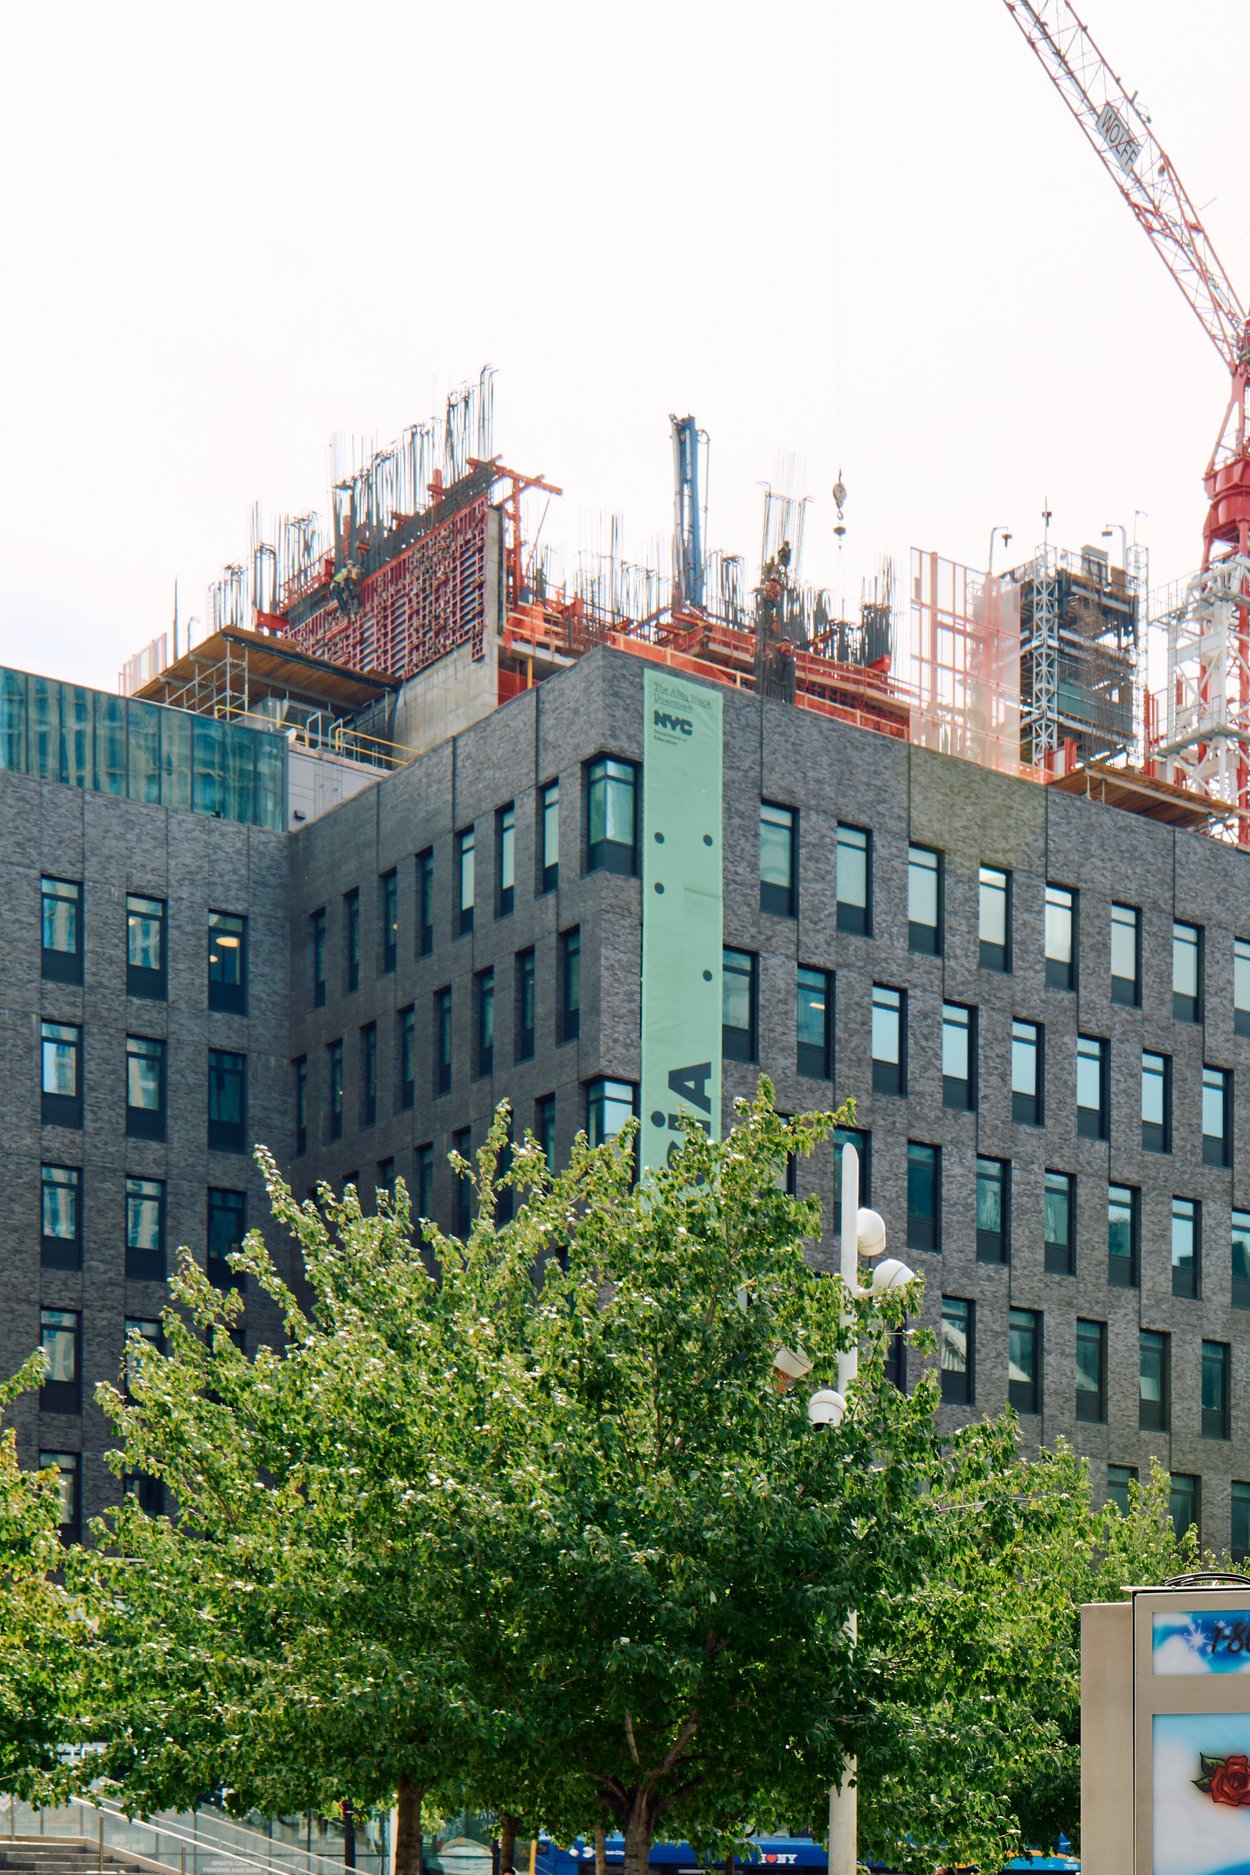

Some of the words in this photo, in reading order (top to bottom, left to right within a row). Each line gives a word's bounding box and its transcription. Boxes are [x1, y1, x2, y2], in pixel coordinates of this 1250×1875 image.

[654, 710, 693, 736] NYC
[761, 1853, 767, 1863] I
[776, 1853, 798, 1864] NY
